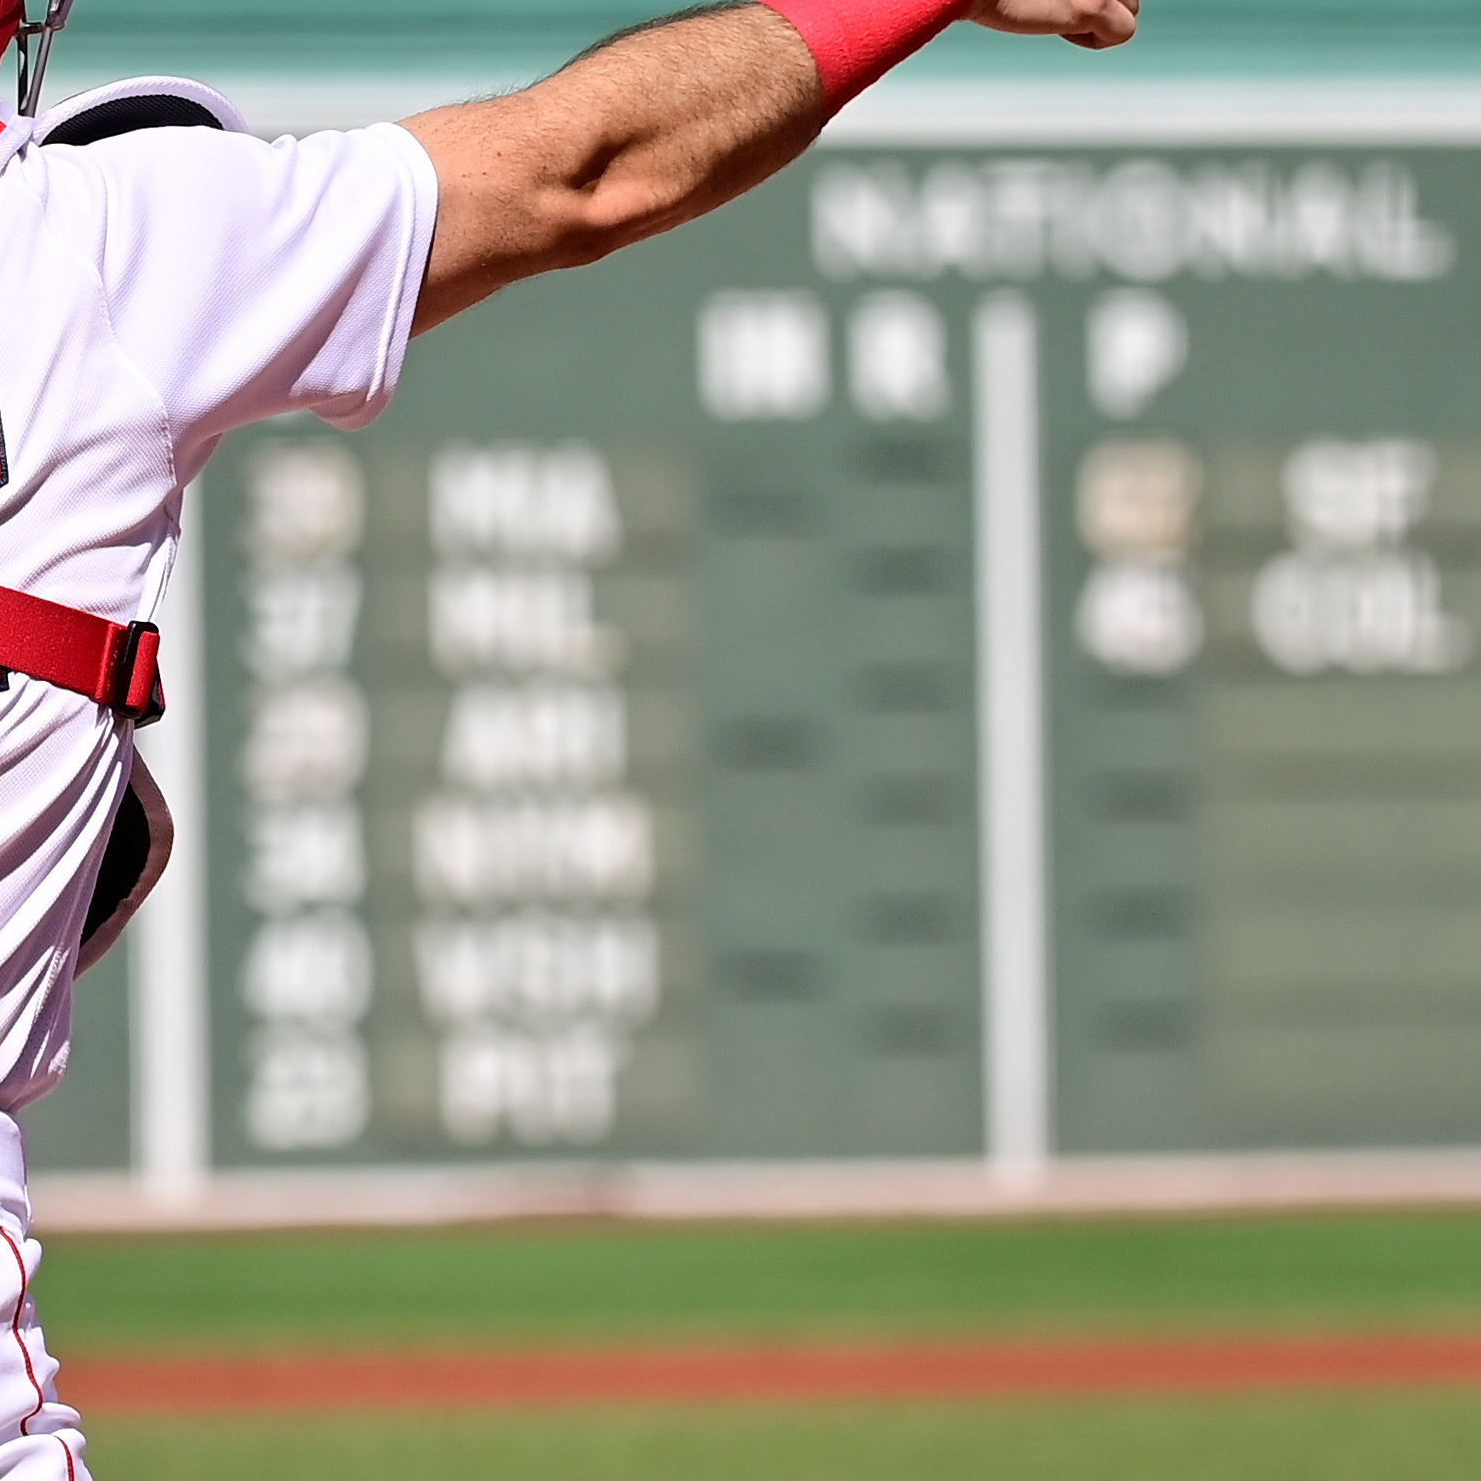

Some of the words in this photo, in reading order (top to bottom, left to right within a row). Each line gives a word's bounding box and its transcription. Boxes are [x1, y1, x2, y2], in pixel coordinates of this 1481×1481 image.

[811, 159, 1451, 279] NATIONAL
[850, 291, 947, 415] R
[1087, 289, 1183, 413] P
[430, 445, 619, 563] MIA
[430, 561, 615, 675] MIL
[1249, 554, 1469, 673] COL
[445, 683, 626, 789] ARI
[414, 795, 652, 901] NYM
[415, 915, 659, 1021] WSH
[440, 1027, 625, 1143] PIT
